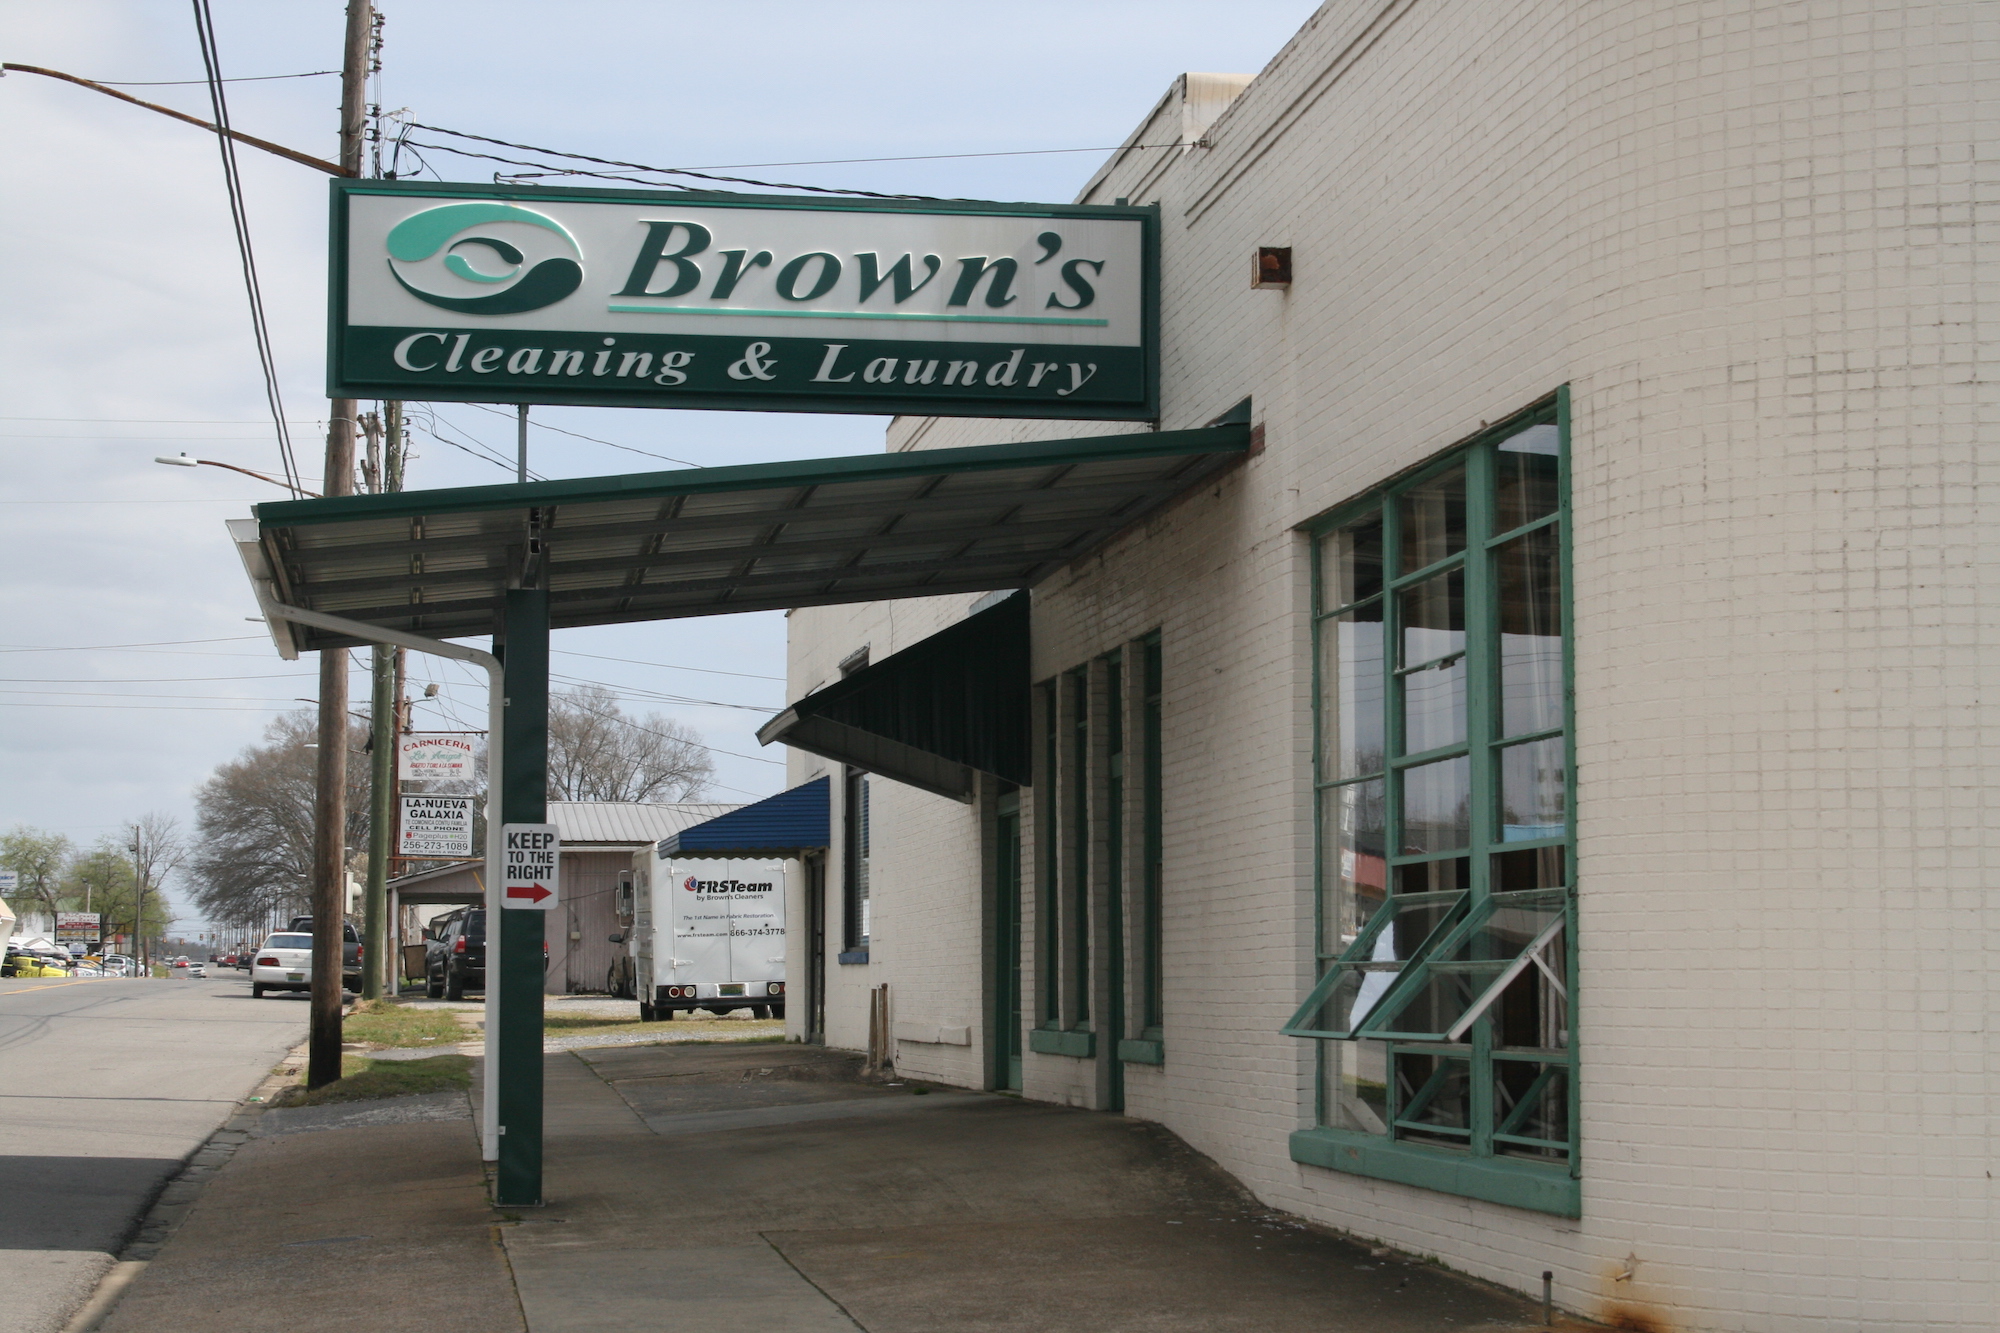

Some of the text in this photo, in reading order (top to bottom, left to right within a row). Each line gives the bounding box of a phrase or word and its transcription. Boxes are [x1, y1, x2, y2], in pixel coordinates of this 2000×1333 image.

[610, 219, 1106, 310] Brown's
[393, 332, 1098, 397] Cleaning & Laundry
[403, 738, 471, 752] CARNICERIA
[406, 799, 468, 809] LA-NUEVA
[410, 809, 464, 819] GALAXIA
[413, 832, 448, 840] Pageplus
[508, 832, 554, 849] KEEP
[403, 841, 468, 851] 256-273-1089
[508, 851, 554, 863] TO THE
[507, 865, 554, 880] RIGHT
[697, 894, 705, 902] by
[730, 928, 785, 936] 866-374-3778
